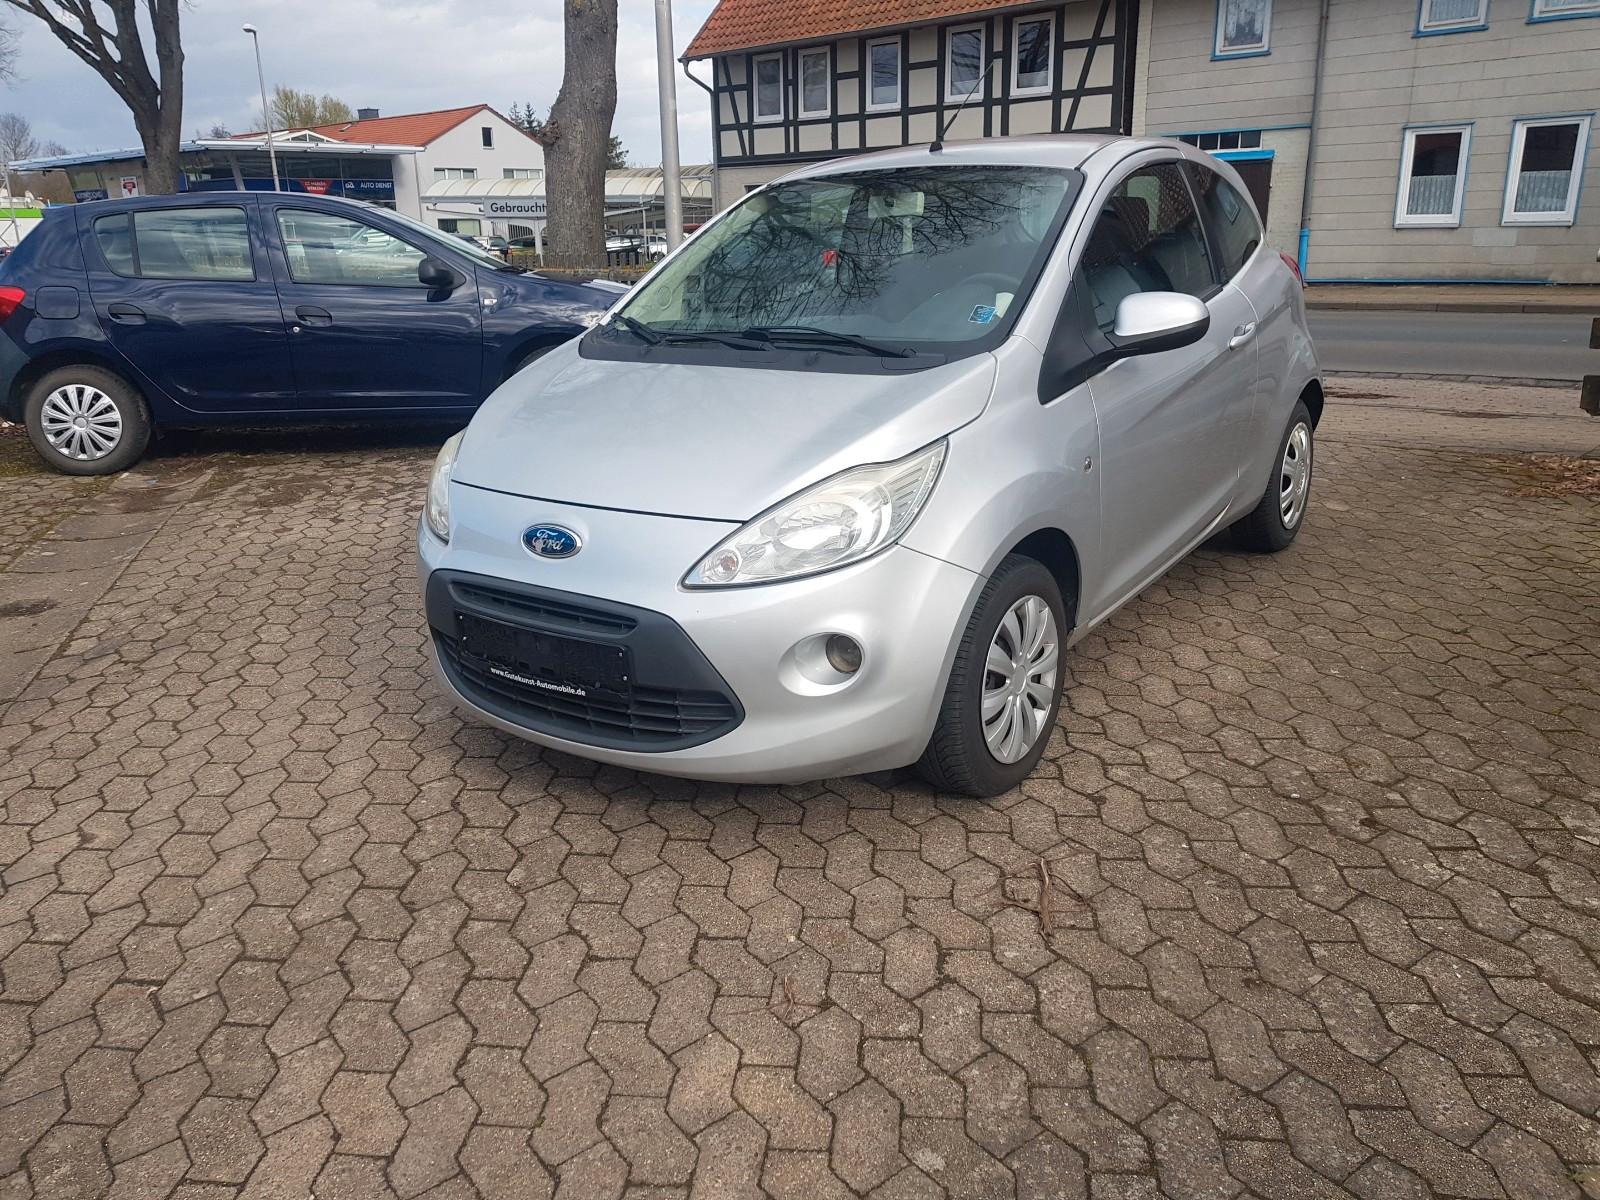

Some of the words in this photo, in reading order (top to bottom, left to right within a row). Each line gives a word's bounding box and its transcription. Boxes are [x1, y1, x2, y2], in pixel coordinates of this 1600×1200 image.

[490, 201, 547, 213] Gebraucht
[532, 529, 565, 551] Ford
[490, 667, 586, 697] www.Gutekunst-Automobile.de
